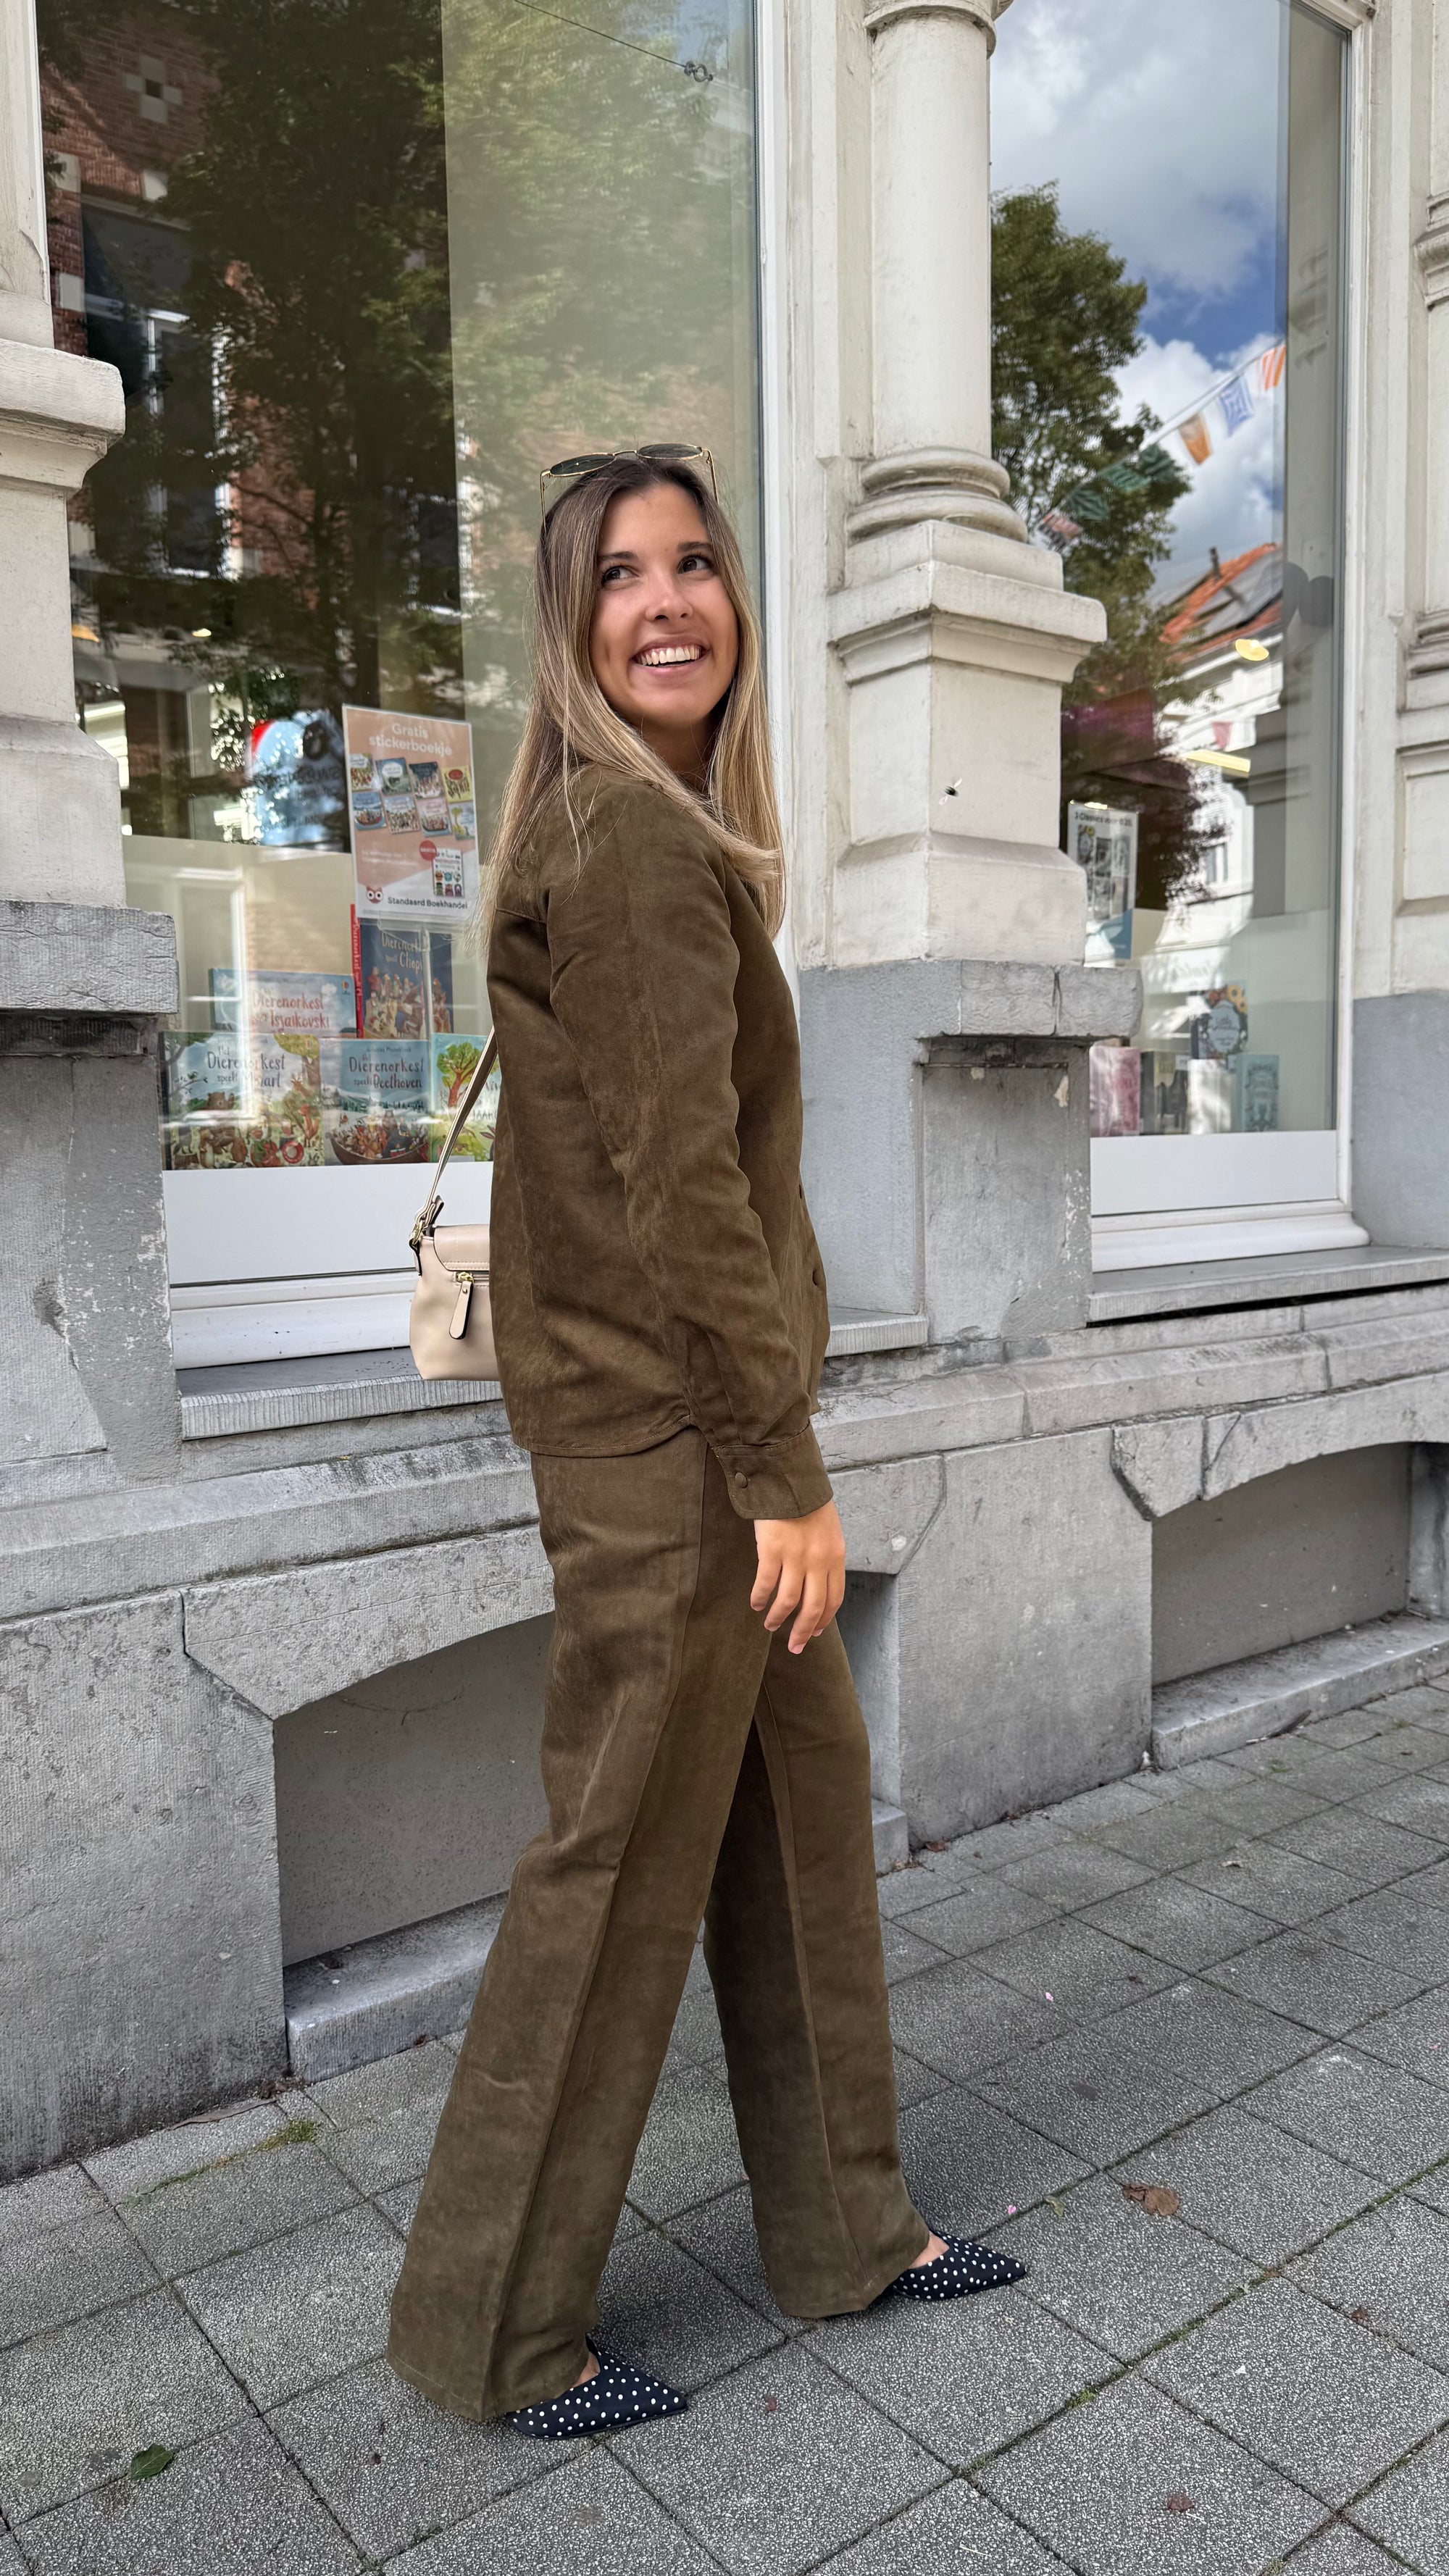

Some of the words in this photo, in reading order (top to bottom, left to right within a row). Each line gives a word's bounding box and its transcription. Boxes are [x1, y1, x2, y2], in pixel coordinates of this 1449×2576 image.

[392, 724, 428, 739] Gratis
[369, 735, 452, 758] stickerboekje
[388, 897, 426, 907] Standaard
[427, 899, 468, 910] Boekhandel
[382, 932, 420, 952] Dierenork
[400, 951, 422, 974] Chopi
[348, 1056, 424, 1073] Dierenorkest
[373, 1074, 422, 1089] Beethoven
